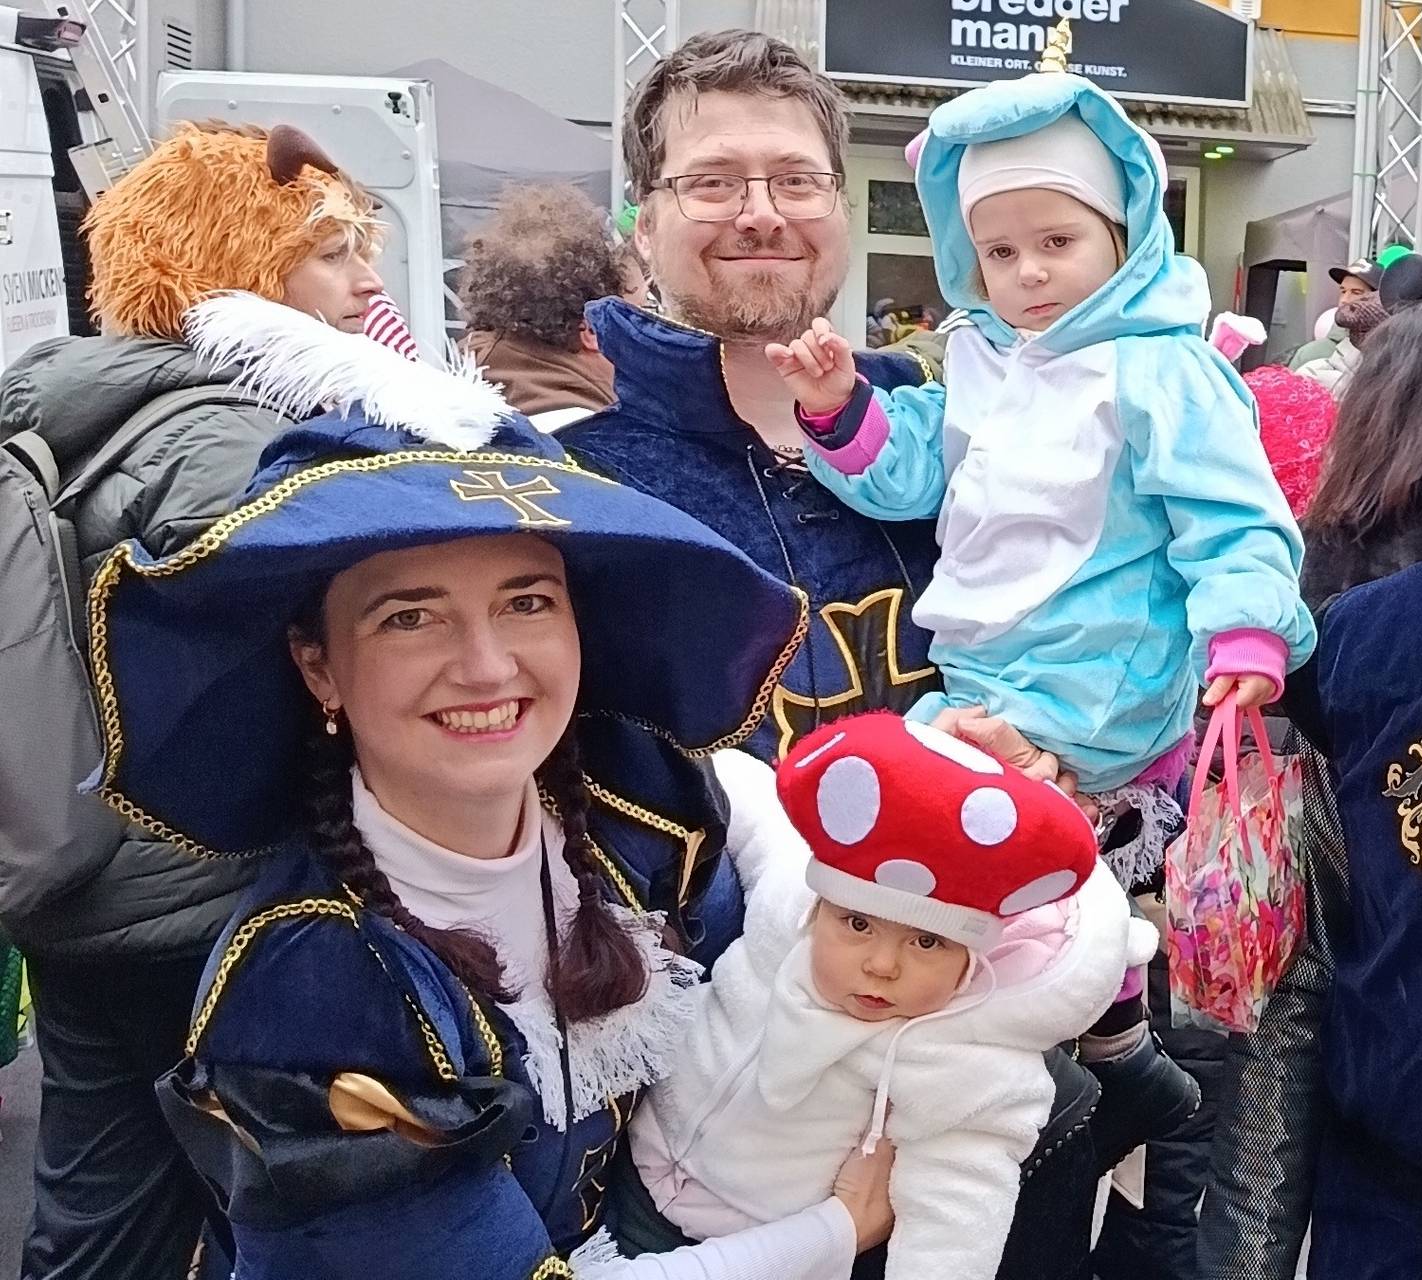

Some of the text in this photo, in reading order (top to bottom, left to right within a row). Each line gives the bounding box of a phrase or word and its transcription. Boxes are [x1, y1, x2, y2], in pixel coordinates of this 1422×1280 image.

[951, 54, 1127, 78] KLEINER ORT. GSE KUNST.
[3, 271, 28, 305] SVEN
